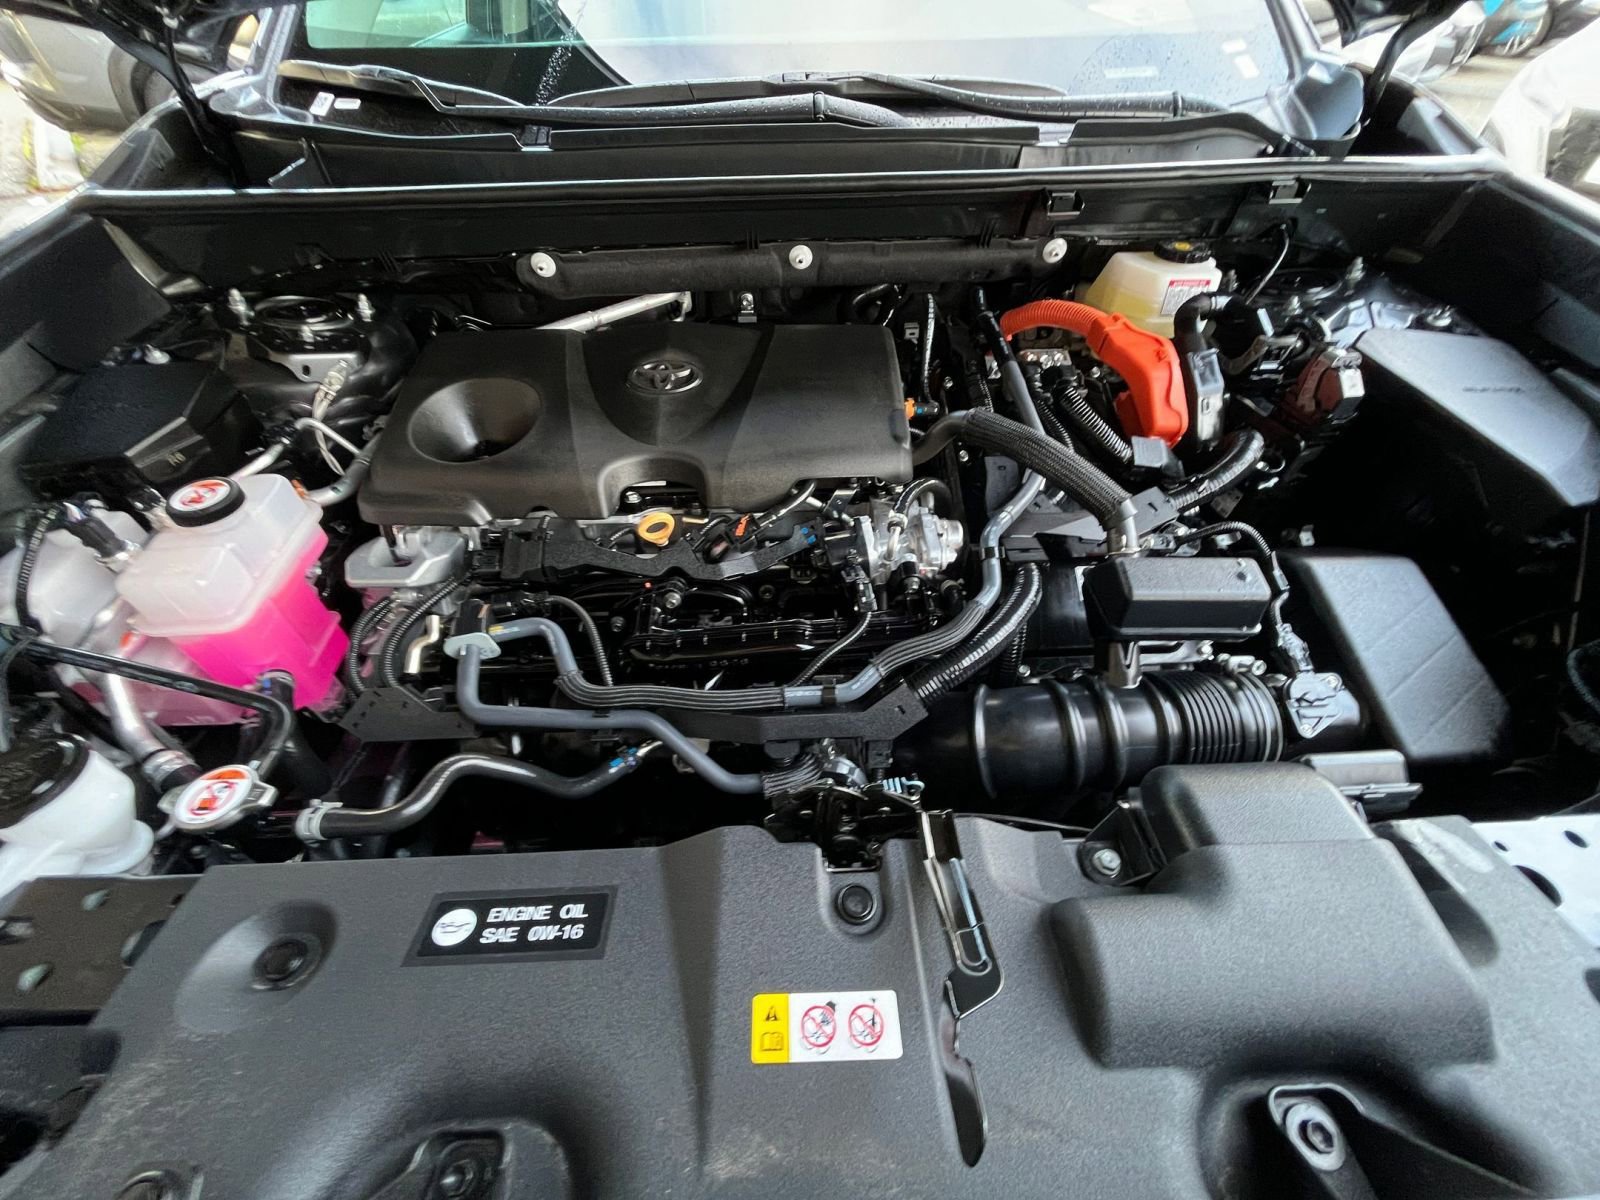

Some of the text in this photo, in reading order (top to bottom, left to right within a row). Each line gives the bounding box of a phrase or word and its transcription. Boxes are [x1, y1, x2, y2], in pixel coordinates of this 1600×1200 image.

[486, 903, 589, 923] ENGINE OIL
[479, 924, 585, 944] SAE 0W-16
